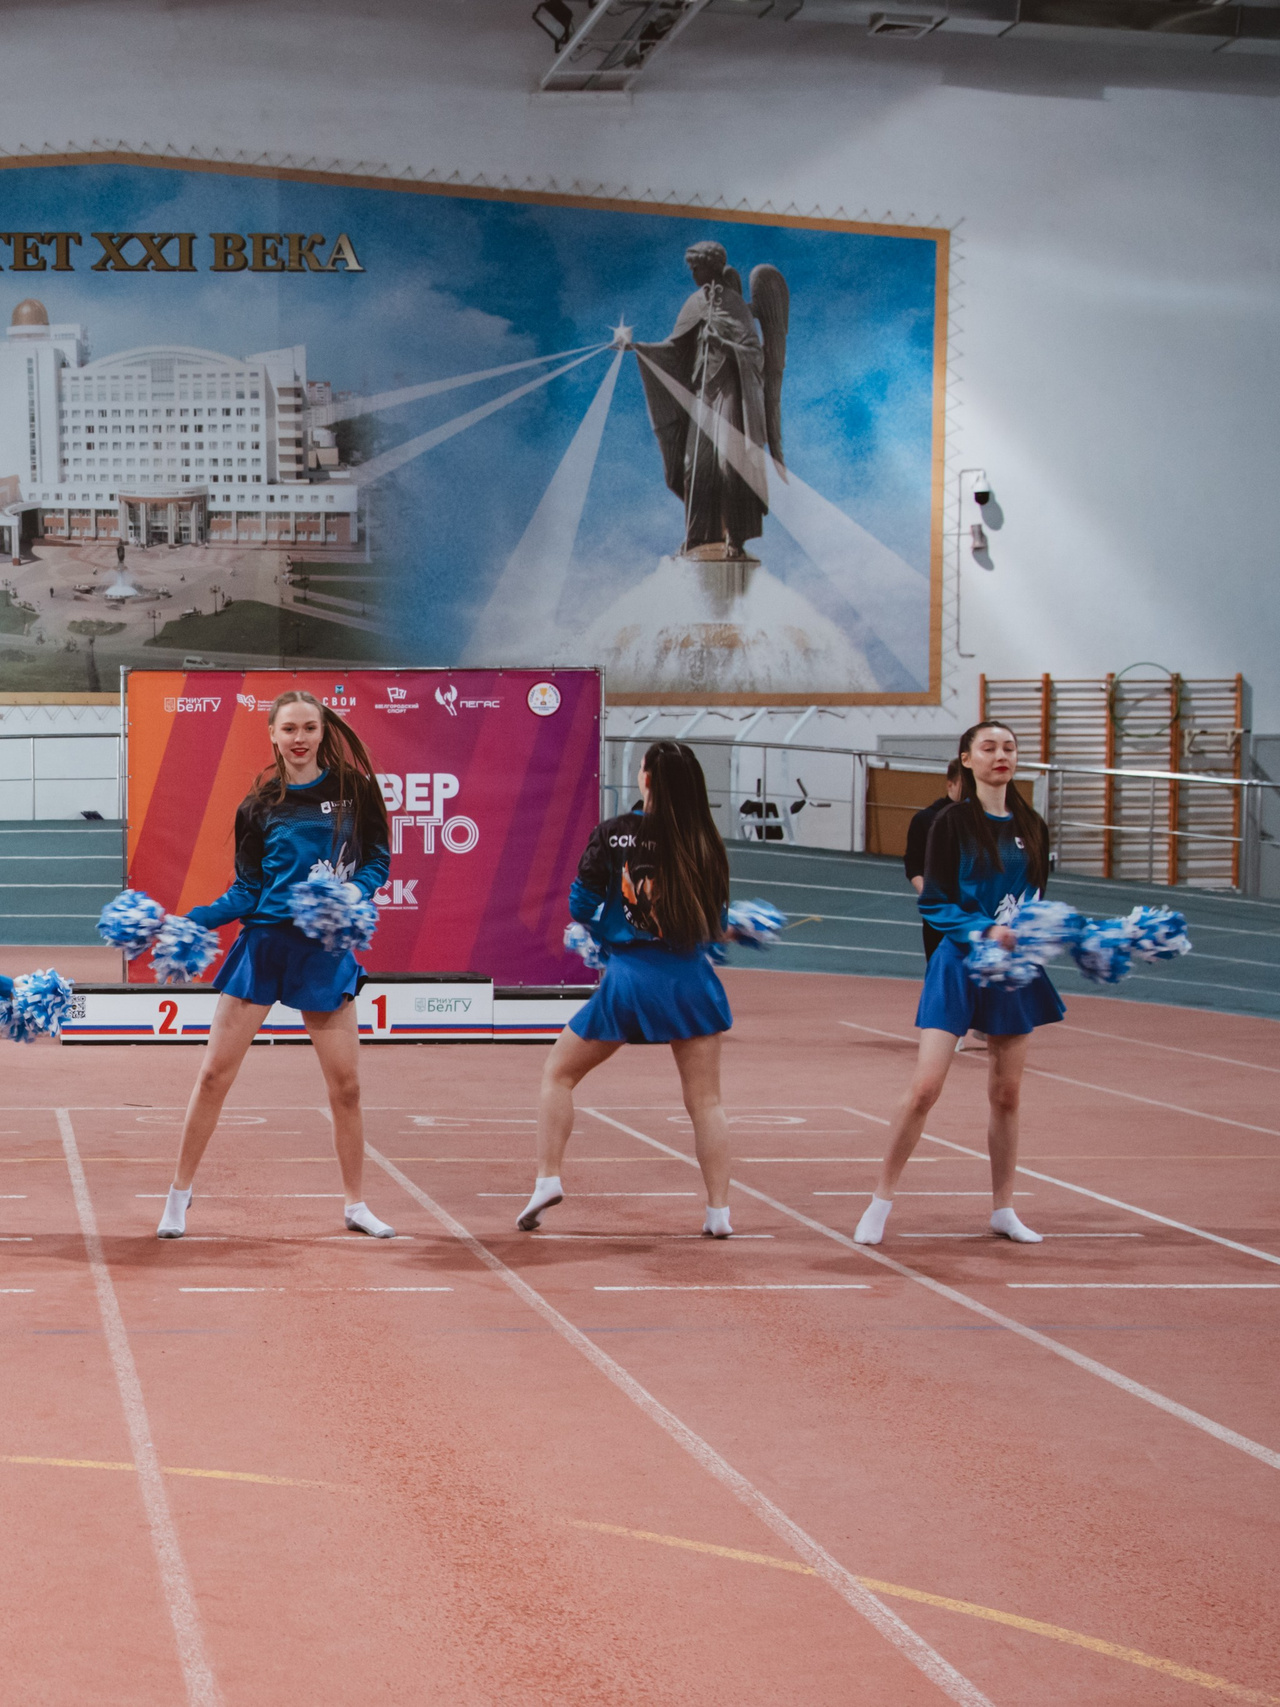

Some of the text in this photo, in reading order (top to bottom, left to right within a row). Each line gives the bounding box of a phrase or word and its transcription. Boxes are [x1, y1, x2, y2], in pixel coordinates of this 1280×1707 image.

[209, 232, 365, 272] ВЕКА
[177, 697, 221, 712] БелГУ
[322, 696, 356, 706] СВОИ
[460, 700, 500, 708] ПЕГАС
[392, 815, 479, 854] ГТО
[609, 835, 637, 848] ССК
[372, 879, 419, 905] СК
[372, 995, 386, 1029] 1
[428, 998, 472, 1012] БелГУ
[159, 1000, 178, 1034] 2
